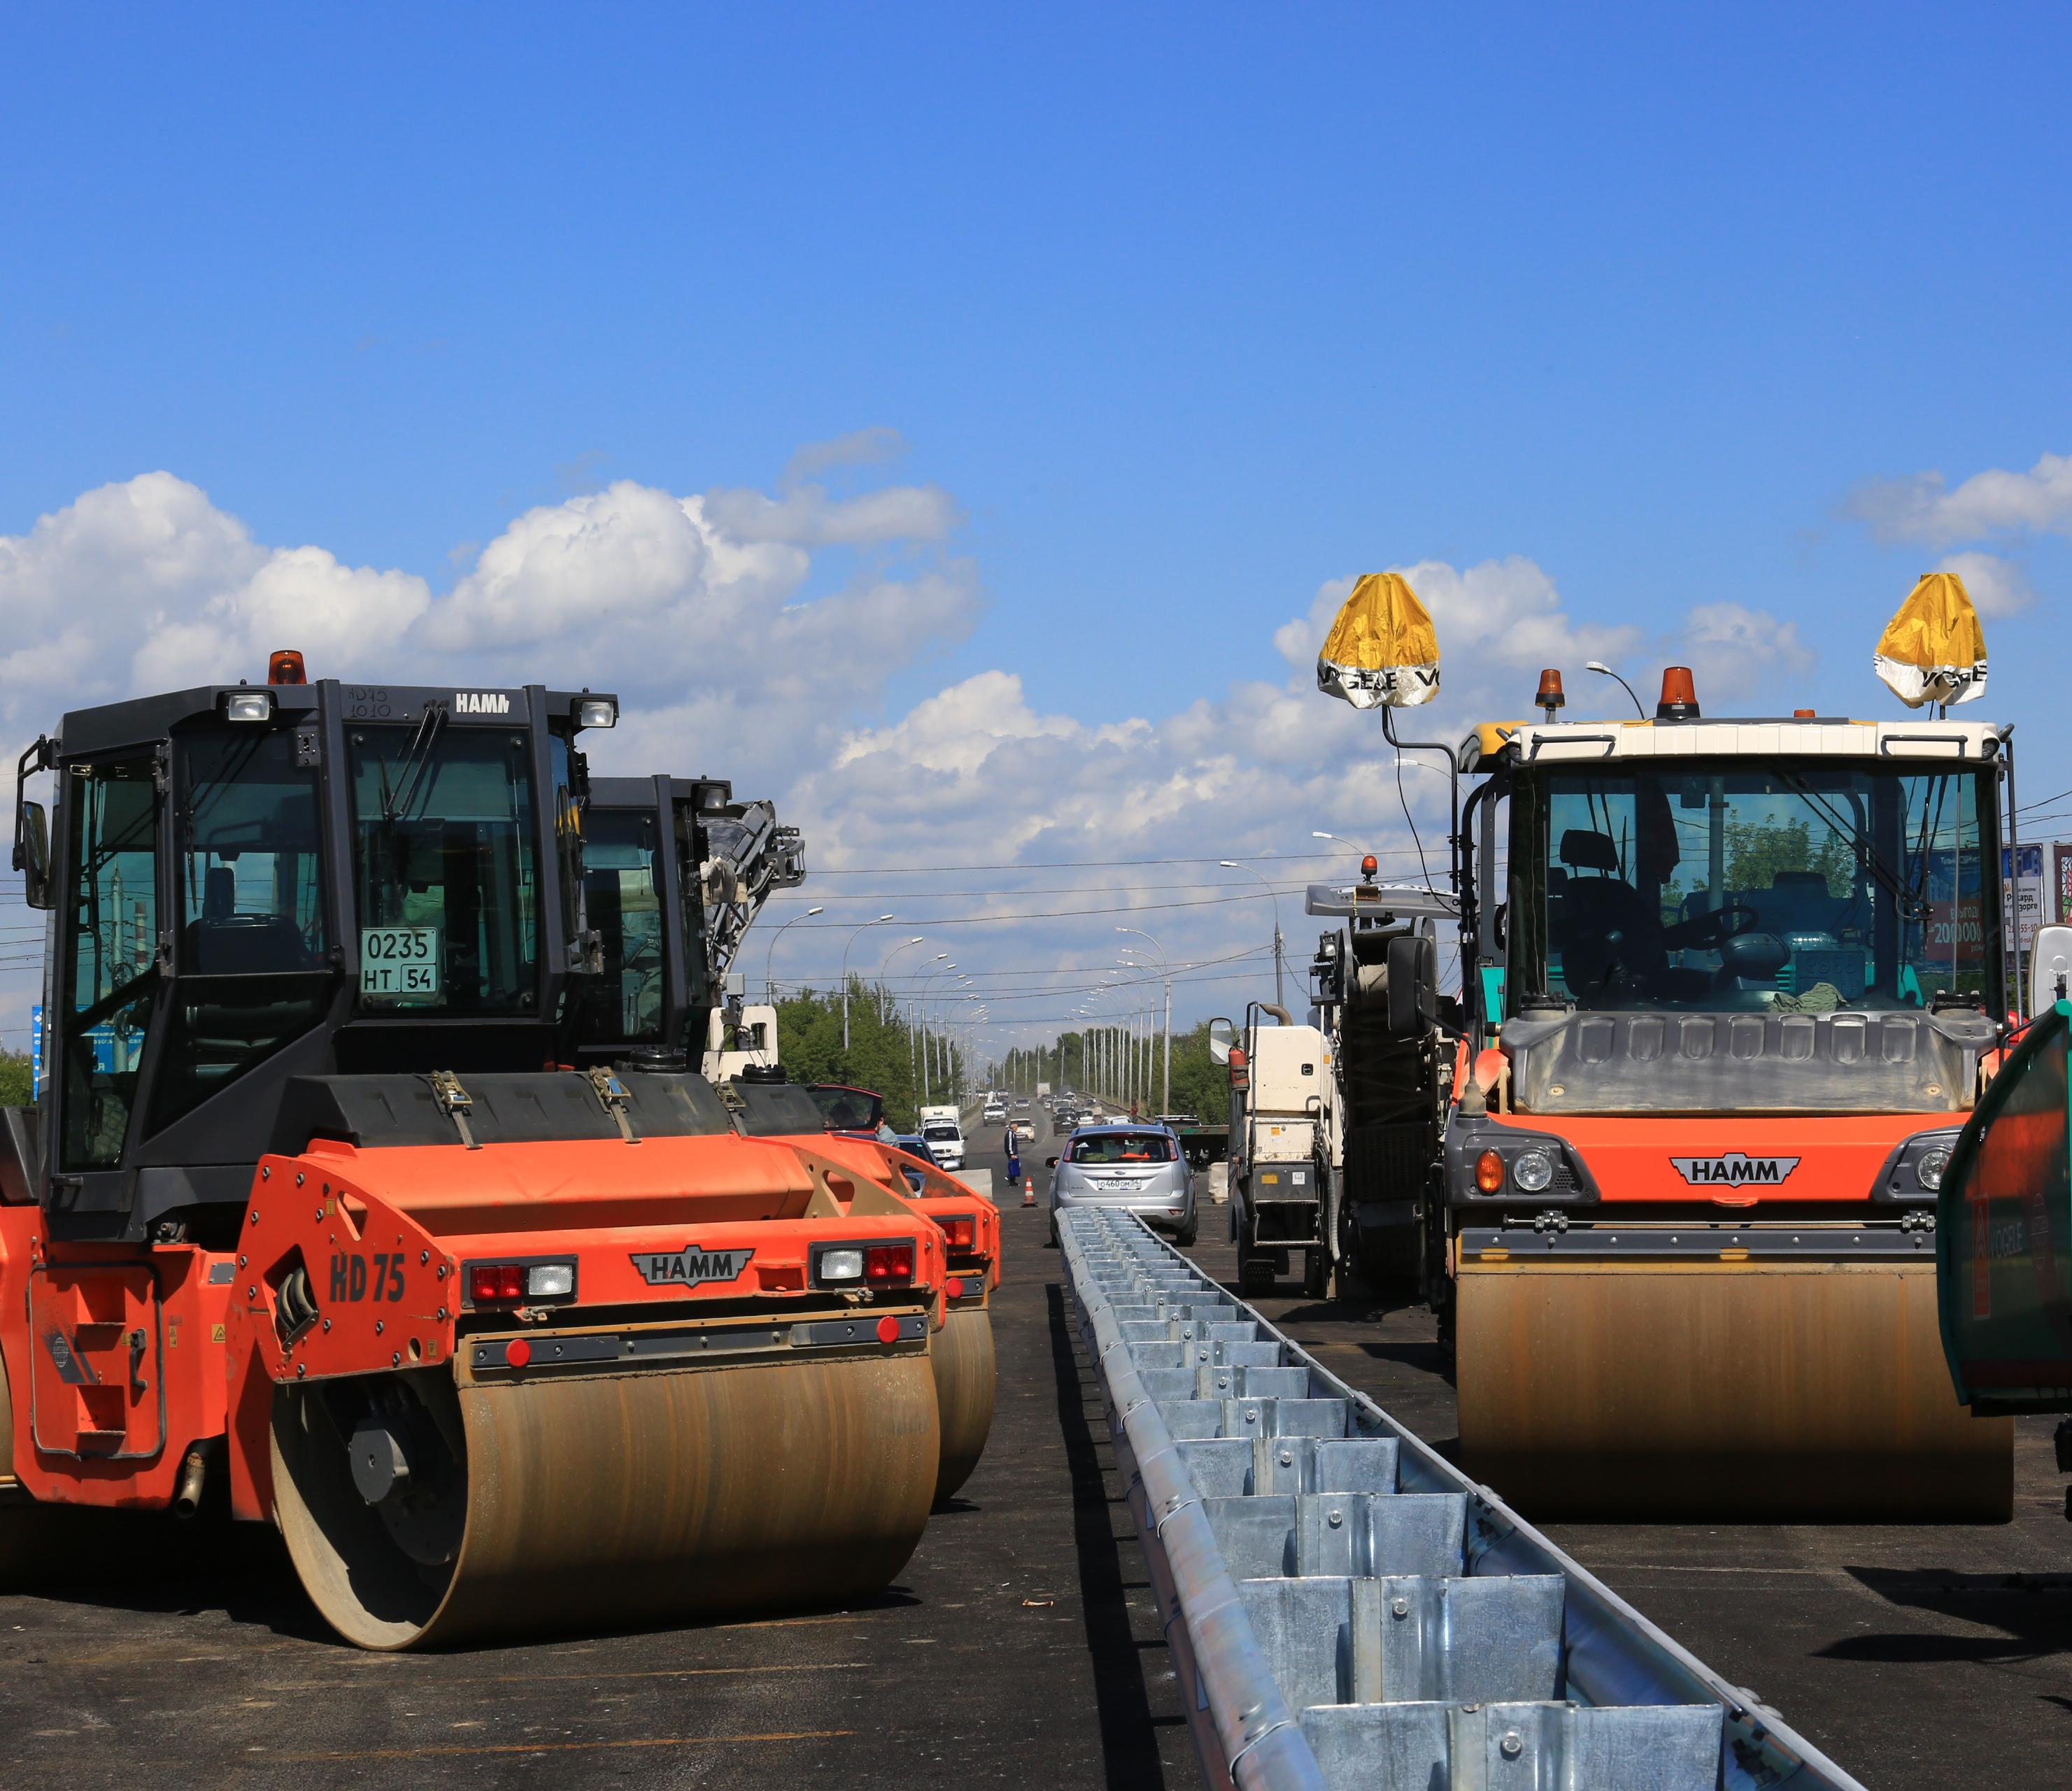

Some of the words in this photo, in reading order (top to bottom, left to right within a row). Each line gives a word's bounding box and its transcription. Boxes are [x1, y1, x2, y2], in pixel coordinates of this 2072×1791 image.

[368, 933, 427, 958] 0235
[407, 969, 430, 989] 54
[1692, 1161, 1779, 1181] HAMM
[329, 1254, 367, 1302] HD
[373, 1253, 405, 1302] 75
[651, 1254, 732, 1280] HAMM
